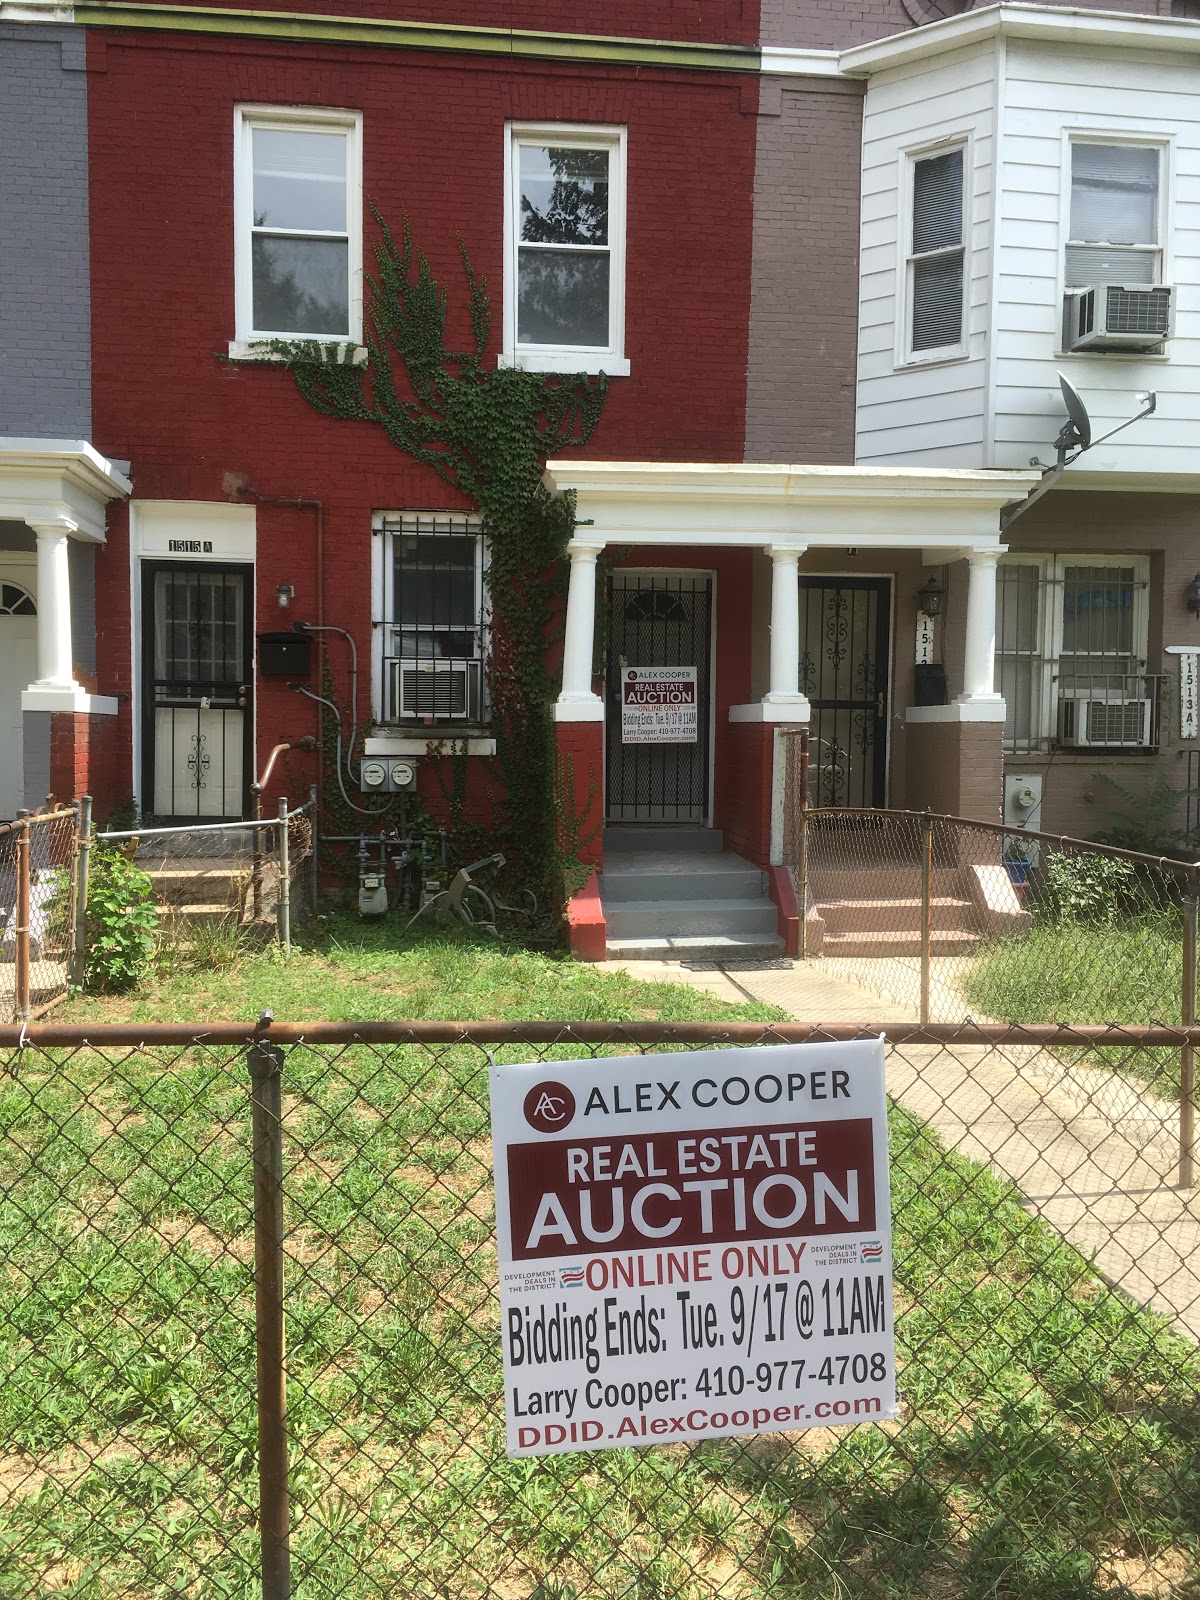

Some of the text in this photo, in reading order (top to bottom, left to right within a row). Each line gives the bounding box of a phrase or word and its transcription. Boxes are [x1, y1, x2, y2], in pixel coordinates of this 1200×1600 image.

[627, 691, 692, 704] AUCTION
[656, 683, 684, 691] ESTATE
[584, 1070, 851, 1115] ALEX COOPER
[567, 1131, 818, 1184] REAL ESTATE
[525, 1169, 860, 1249] AUCTION
[585, 1242, 807, 1292] ONLINE ONLY
[811, 1243, 857, 1252] DEVELOPMENT
[828, 1257, 857, 1265] DISTRICT
[504, 1270, 556, 1281] DEVELOPMENT
[524, 1282, 556, 1291] DISTRICT
[508, 1302, 600, 1374] Bidding
[604, 1295, 667, 1357] Ends:
[676, 1291, 725, 1350] Tue.
[513, 1352, 887, 1419] Larry Cooper: 410-977-4708
[518, 1396, 882, 1449] DDID.AlexCooper.com
